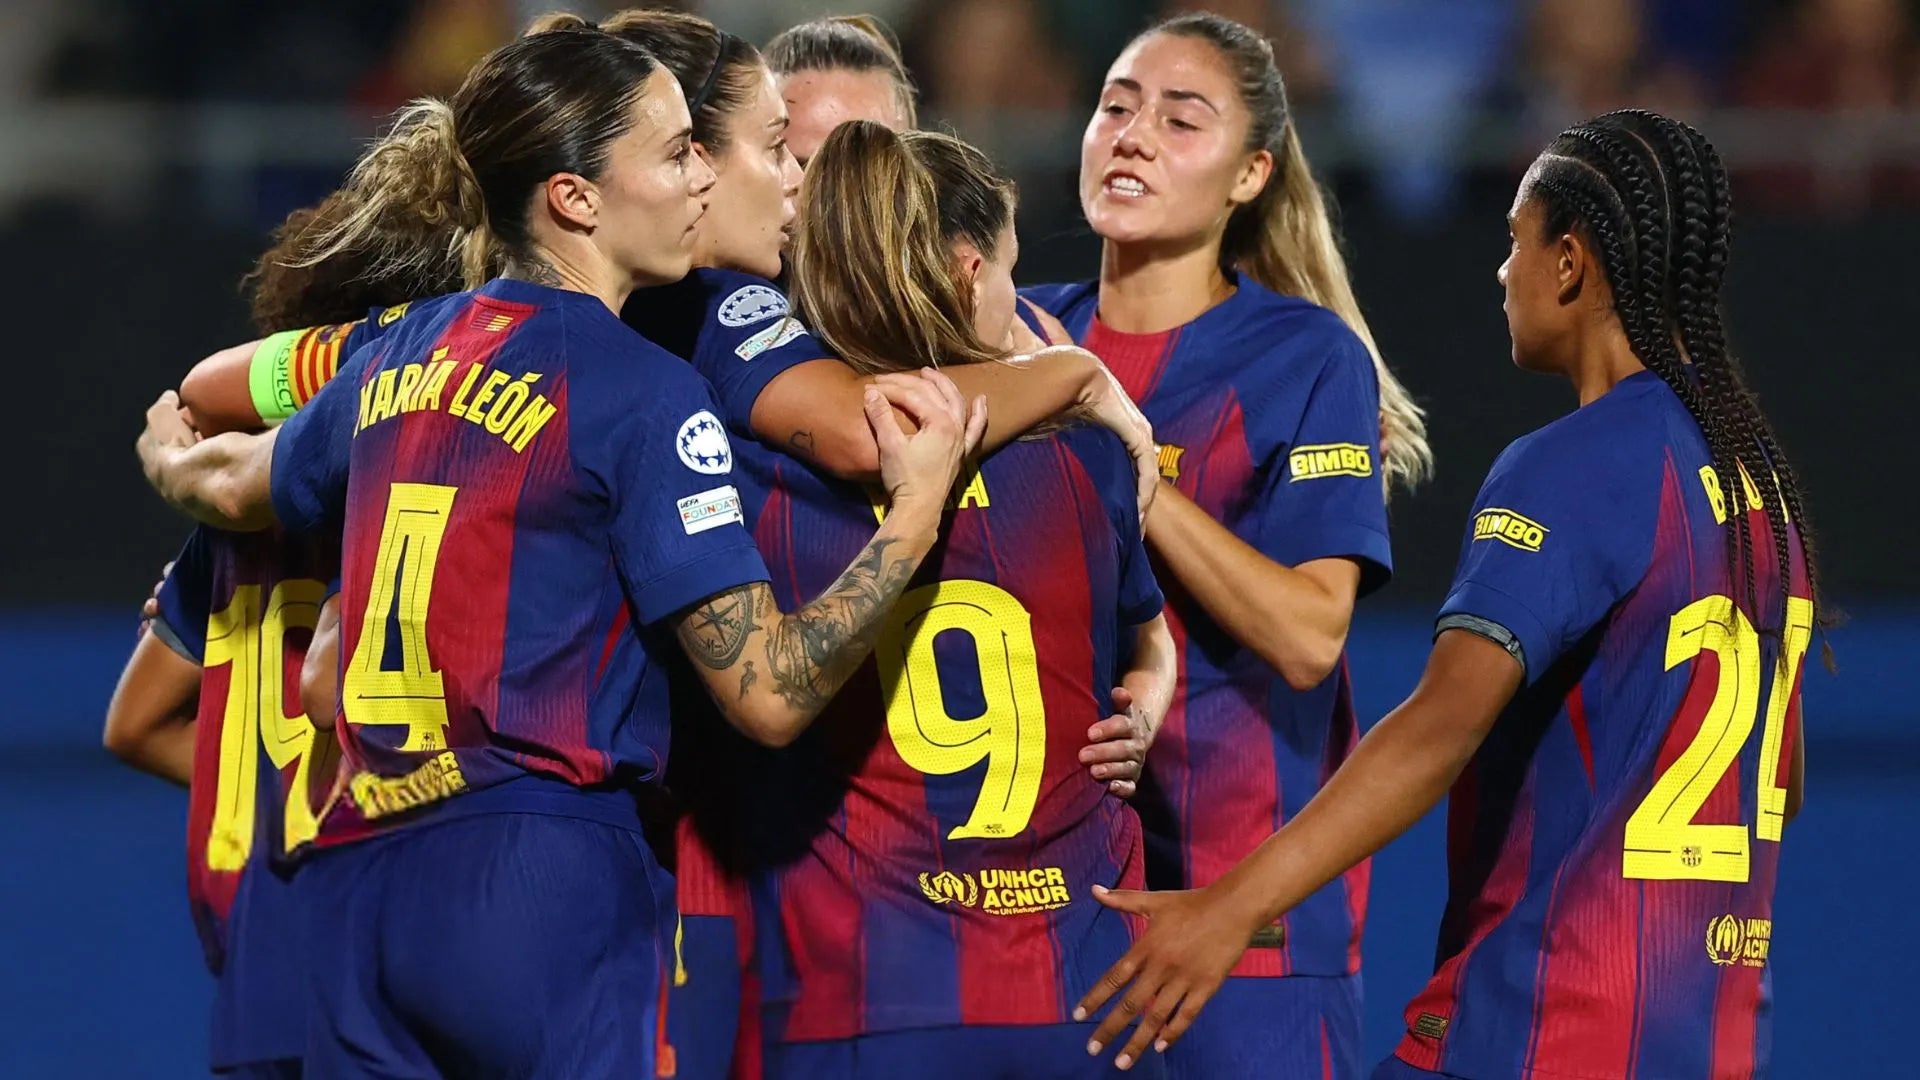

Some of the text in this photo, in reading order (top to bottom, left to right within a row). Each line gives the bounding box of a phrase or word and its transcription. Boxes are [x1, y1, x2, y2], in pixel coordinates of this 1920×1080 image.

[448, 362, 557, 454] LEÓN
[1290, 448, 1371, 476] BIMBO
[680, 499, 699, 509] UEFA
[1474, 514, 1544, 547] BIMBO
[342, 483, 458, 751] 4
[203, 579, 333, 870] 19
[875, 579, 1046, 840] 9
[980, 867, 1065, 889] UNHCR
[982, 885, 1070, 909] ACNUR
[1000, 908, 1012, 916] UN
[1013, 905, 1043, 914] Refugee
